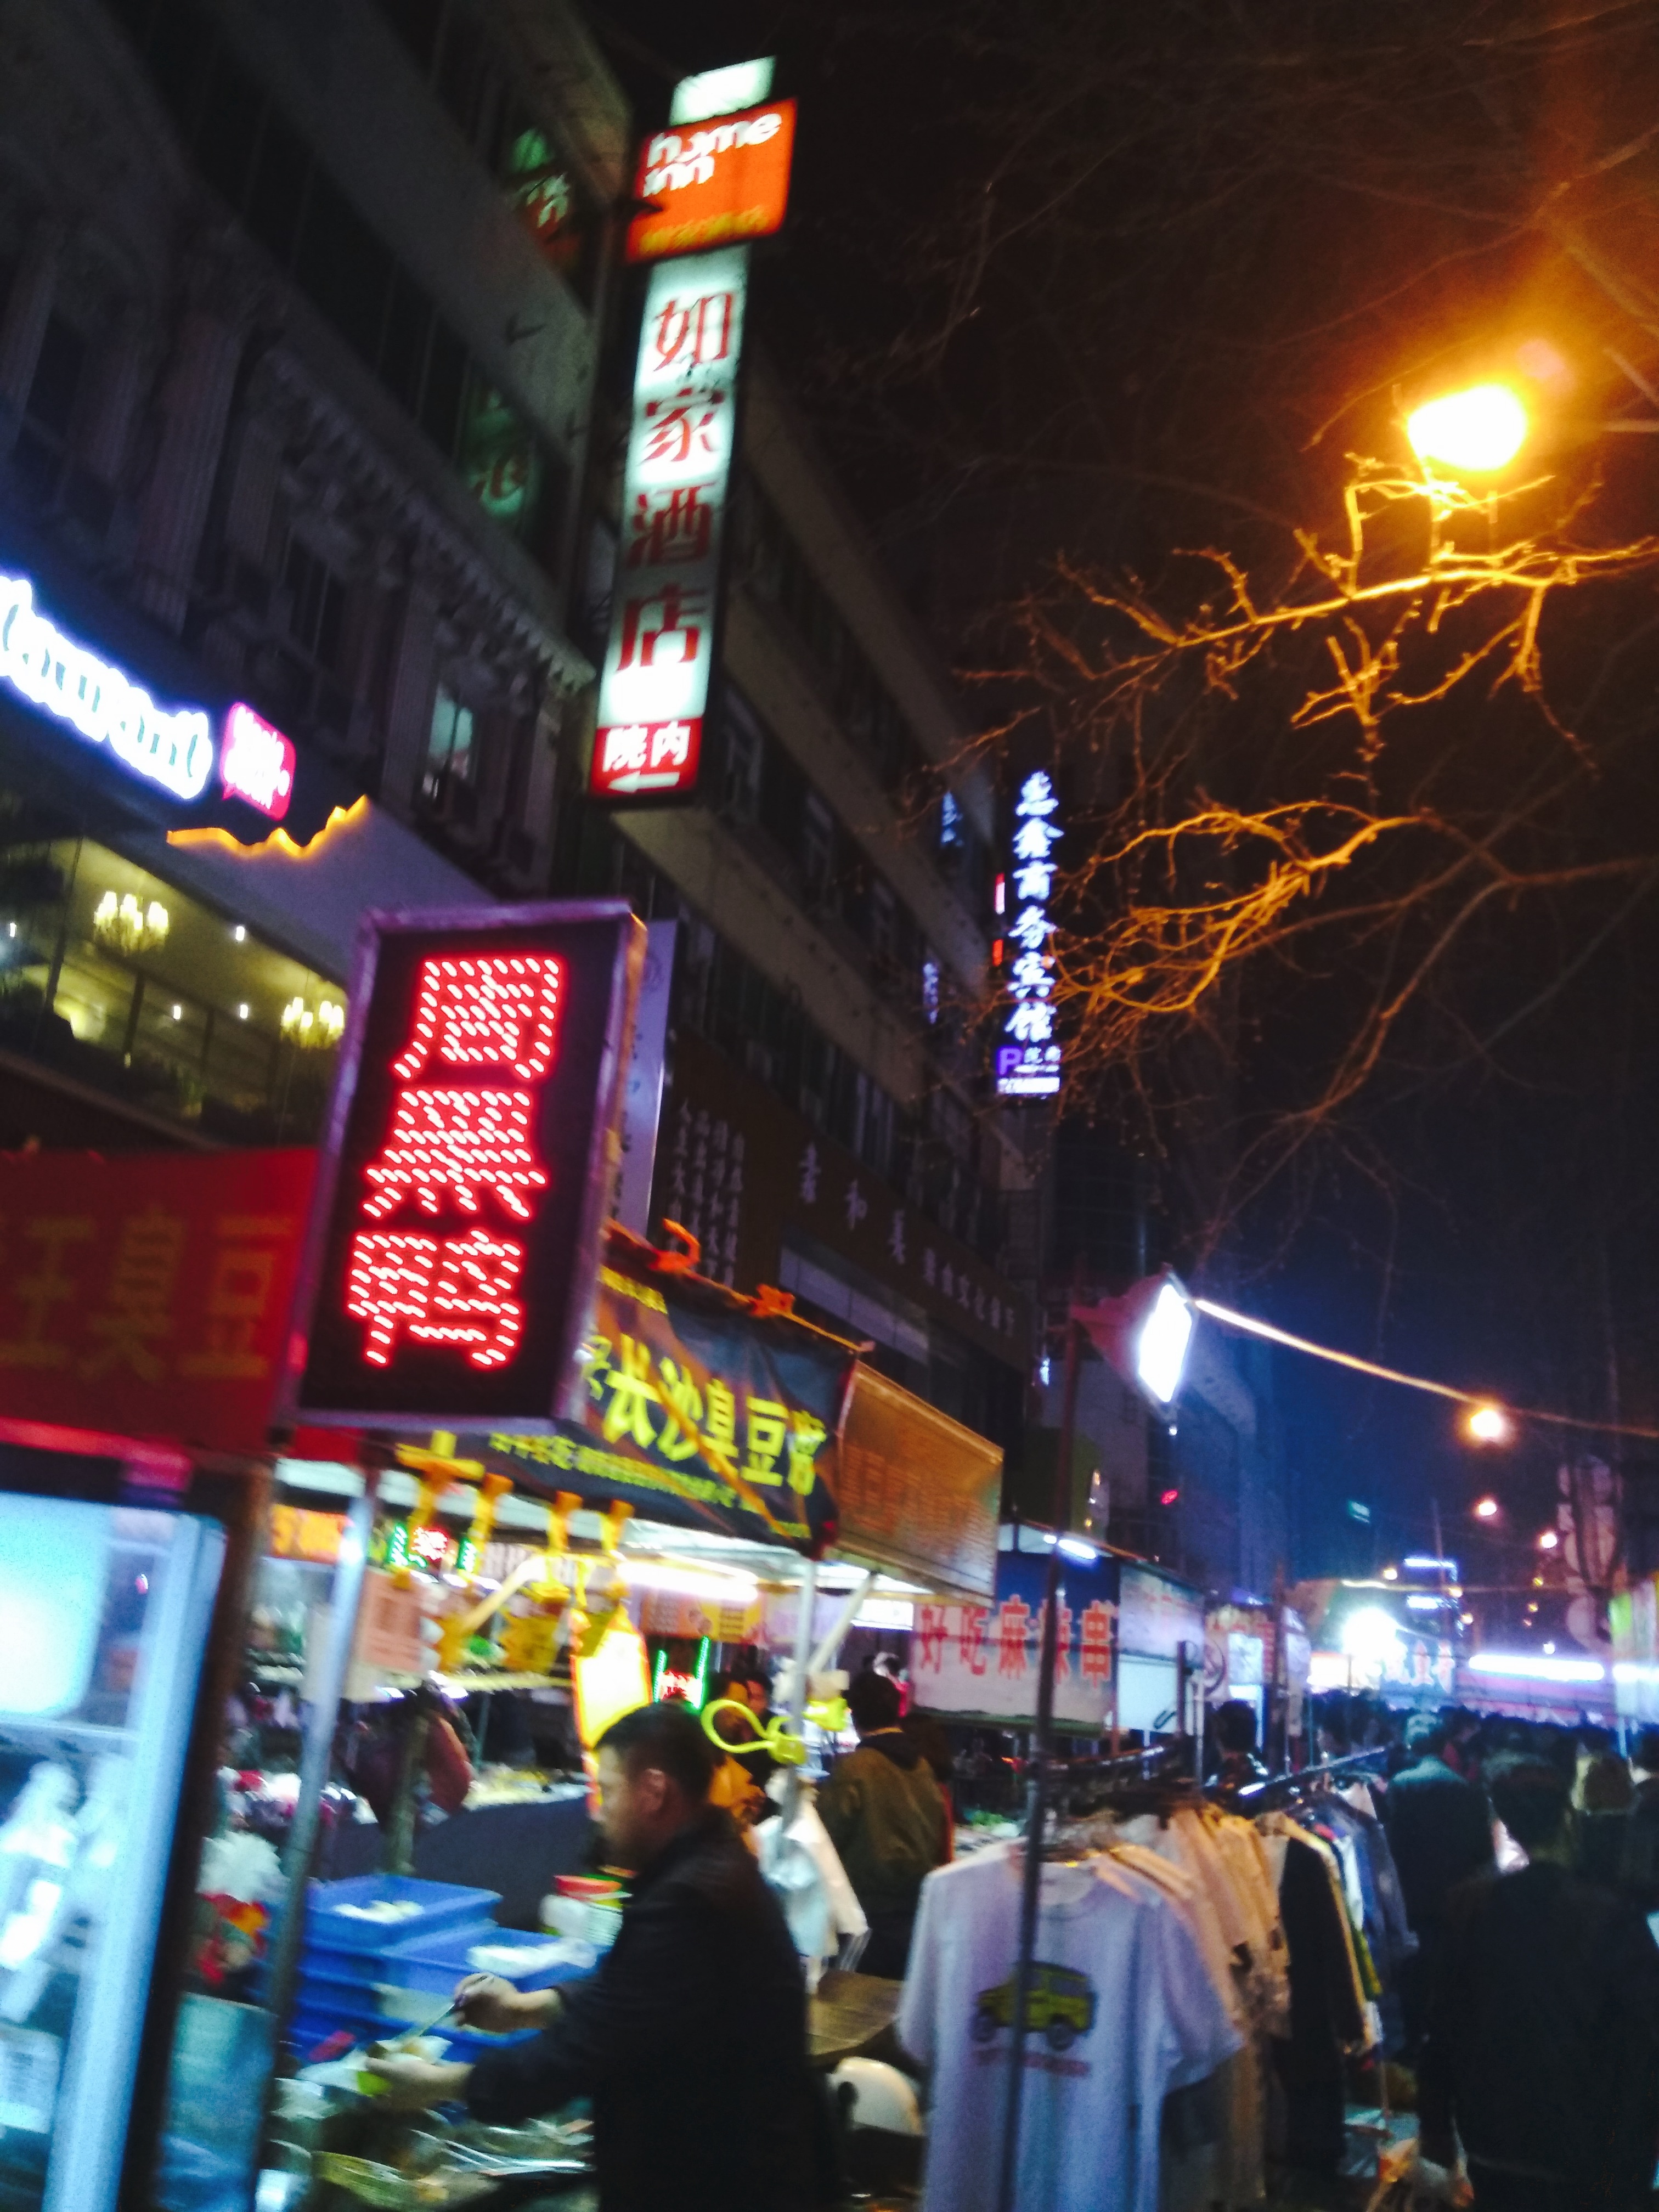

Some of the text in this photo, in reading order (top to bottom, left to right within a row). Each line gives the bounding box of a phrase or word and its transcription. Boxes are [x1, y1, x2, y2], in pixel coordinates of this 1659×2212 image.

[647, 112, 782, 168] home
[642, 155, 715, 198] inn
[616, 292, 734, 672] 如家酒店
[602, 724, 691, 772] 院内
[346, 957, 561, 1366] 周黑鸭
